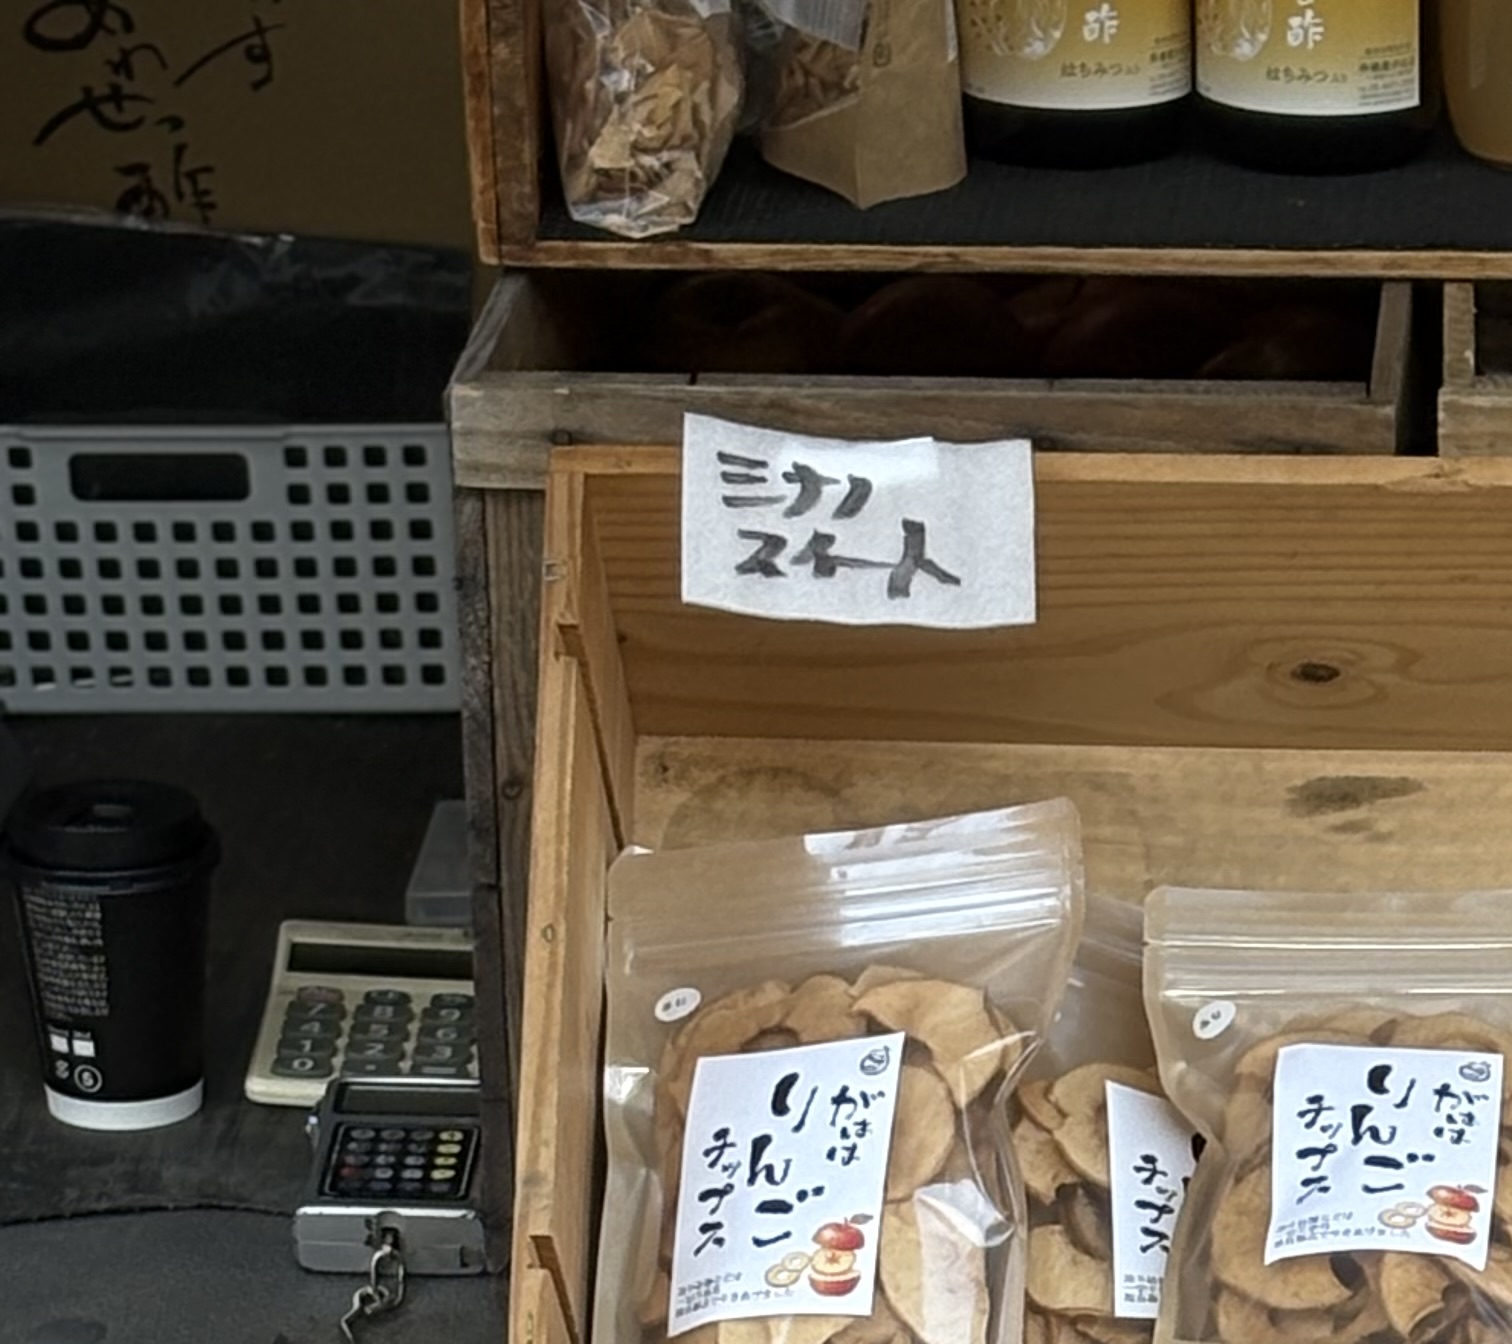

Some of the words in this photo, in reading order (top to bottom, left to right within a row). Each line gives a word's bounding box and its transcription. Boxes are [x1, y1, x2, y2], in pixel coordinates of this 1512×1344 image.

[1286, 0, 1325, 49] 酢
[747, 1072, 826, 1248] りんご
[826, 1084, 885, 1167] がはは
[1296, 1095, 1343, 1205] チップス
[1350, 1064, 1436, 1195] りんご
[1433, 1083, 1489, 1145] がはは
[693, 1127, 741, 1257] チップス
